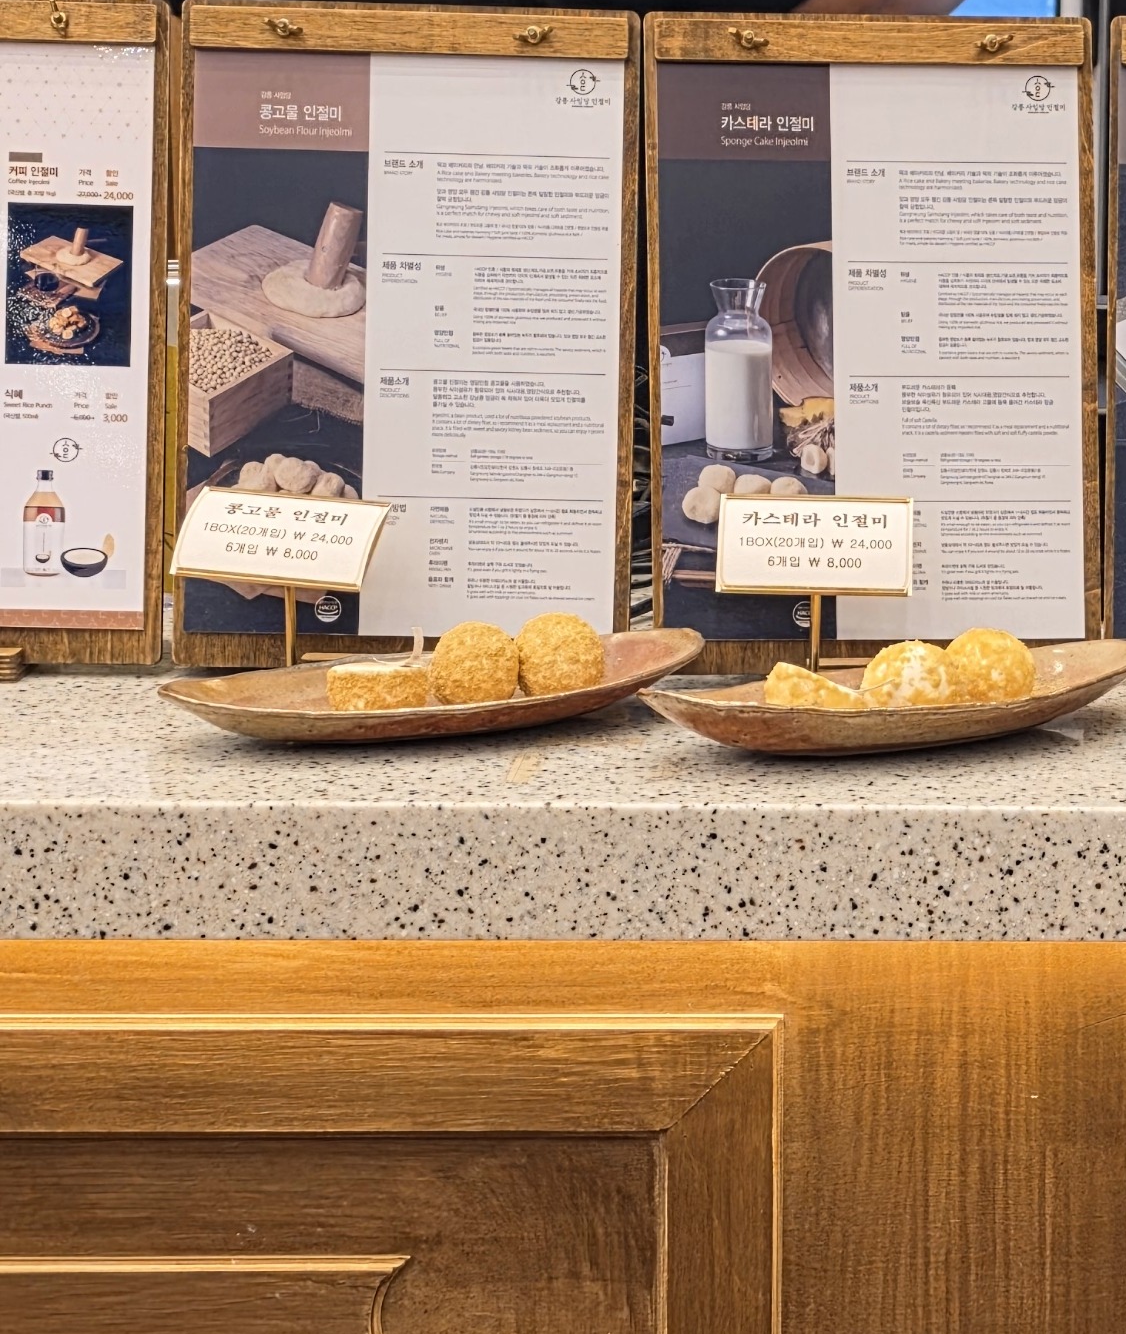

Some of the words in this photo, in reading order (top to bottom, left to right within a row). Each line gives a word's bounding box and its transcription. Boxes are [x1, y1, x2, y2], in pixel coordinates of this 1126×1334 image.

[260, 104, 298, 120] 콩고물
[303, 105, 341, 122] 인절미
[721, 115, 772, 131] 카스테라
[777, 116, 814, 132] 인절미
[260, 125, 294, 136] Soybean
[297, 126, 317, 135] Flour
[319, 127, 352, 137] Injeolmi
[721, 136, 752, 147] Sponge
[754, 137, 774, 145] Cake
[776, 137, 808, 147] Injeolmi
[384, 160, 406, 168] 브랜드
[409, 160, 424, 169] 소개
[9, 166, 27, 176] 커피
[31, 167, 58, 177] 인절미
[847, 168, 868, 177] 브랜드
[871, 169, 885, 177] 소개
[104, 192, 134, 200] 24,000
[382, 261, 397, 270] 제품
[400, 261, 421, 271] 차별성
[848, 269, 863, 278] 제품
[865, 269, 887, 278] 차별성
[380, 377, 410, 386] 제품소개
[849, 383, 879, 392] 제품소개
[5, 389, 23, 399] 식혜
[103, 414, 128, 423] 3,000
[225, 503, 282, 519] 콩고물
[293, 510, 348, 526] 인절미
[743, 512, 821, 527] 카스테라
[833, 514, 888, 529] 인절미
[204, 522, 287, 540] 1BOX(20개입)
[311, 533, 353, 546] 24,000
[740, 537, 824, 549] 1BOX(20개입)
[850, 540, 892, 550] 24,000
[225, 542, 258, 554] 6개입
[284, 548, 318, 561] 8,000
[768, 556, 800, 568] 6개입
[827, 558, 862, 568] 8,000
